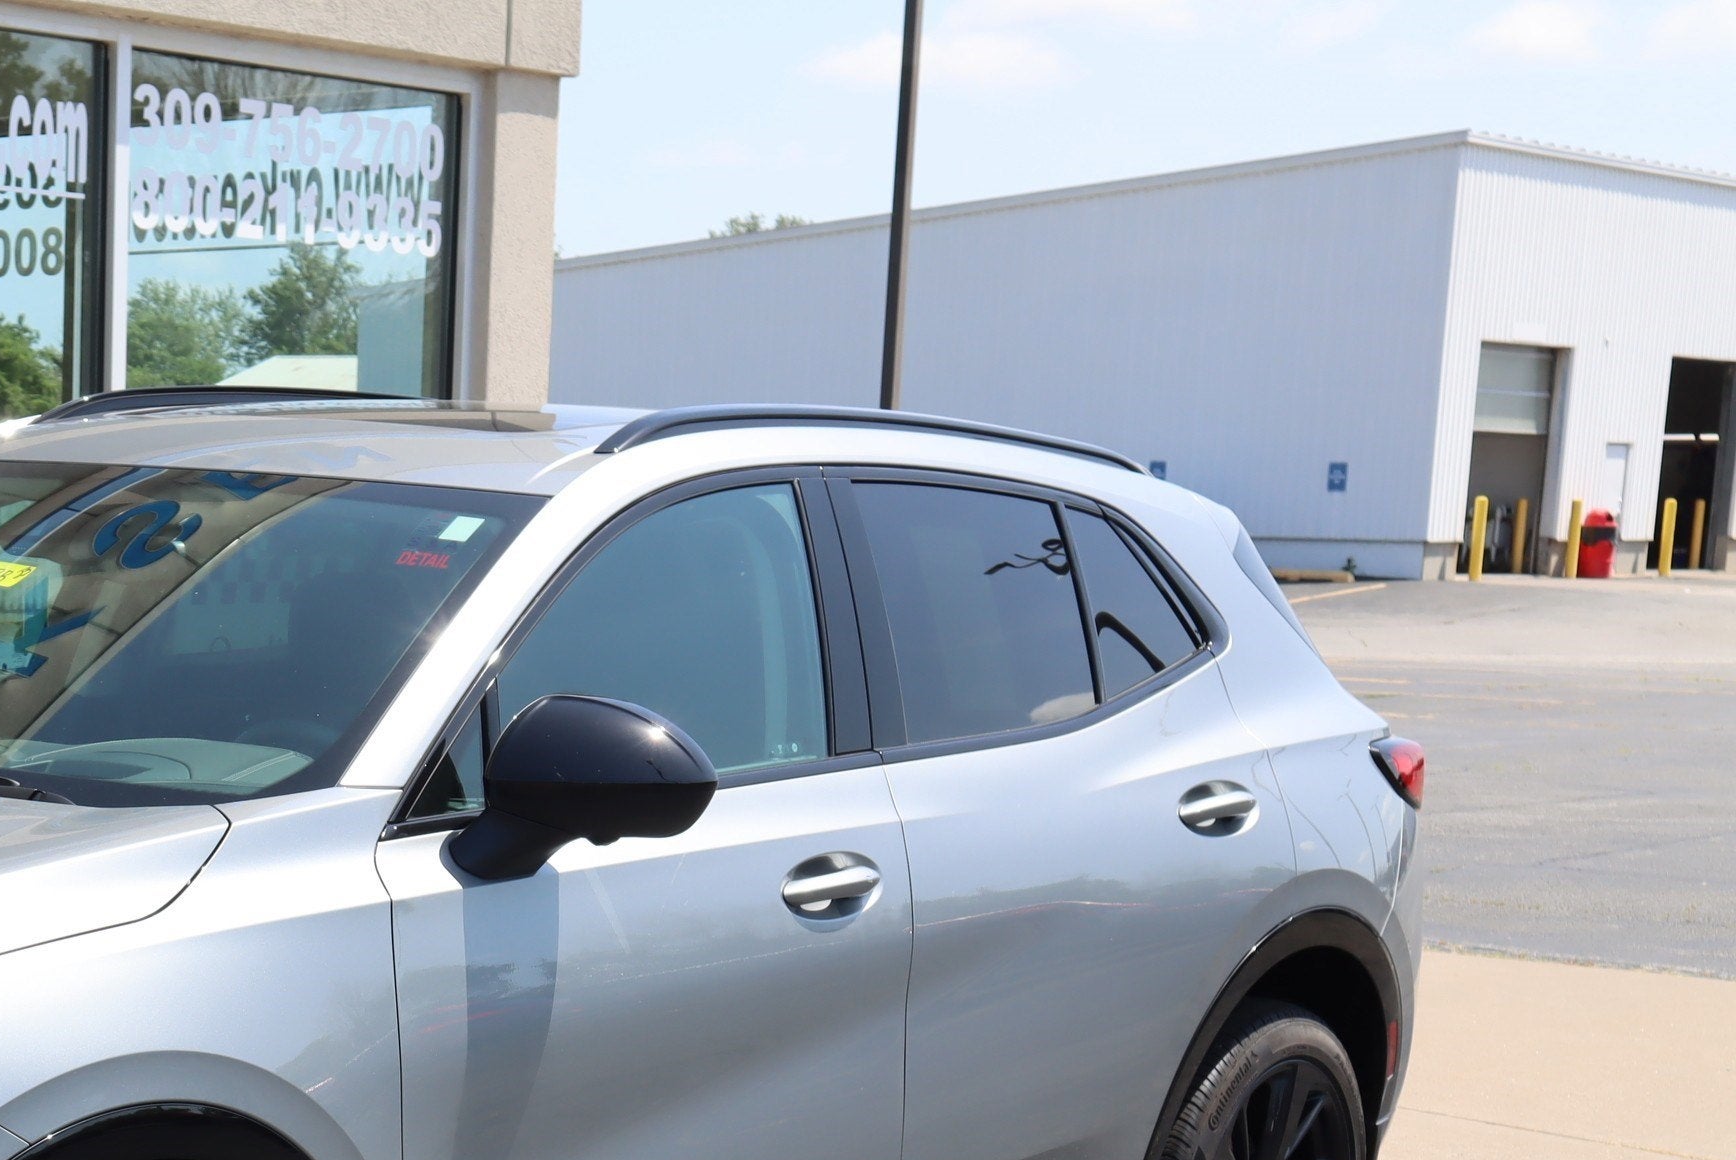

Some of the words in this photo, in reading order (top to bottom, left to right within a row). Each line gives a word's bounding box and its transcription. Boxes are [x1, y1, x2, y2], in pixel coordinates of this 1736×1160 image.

[133, 83, 445, 182] 309-756-2700
[131, 167, 443, 258] 800-211-9335
[395, 550, 451, 569] DETAIL
